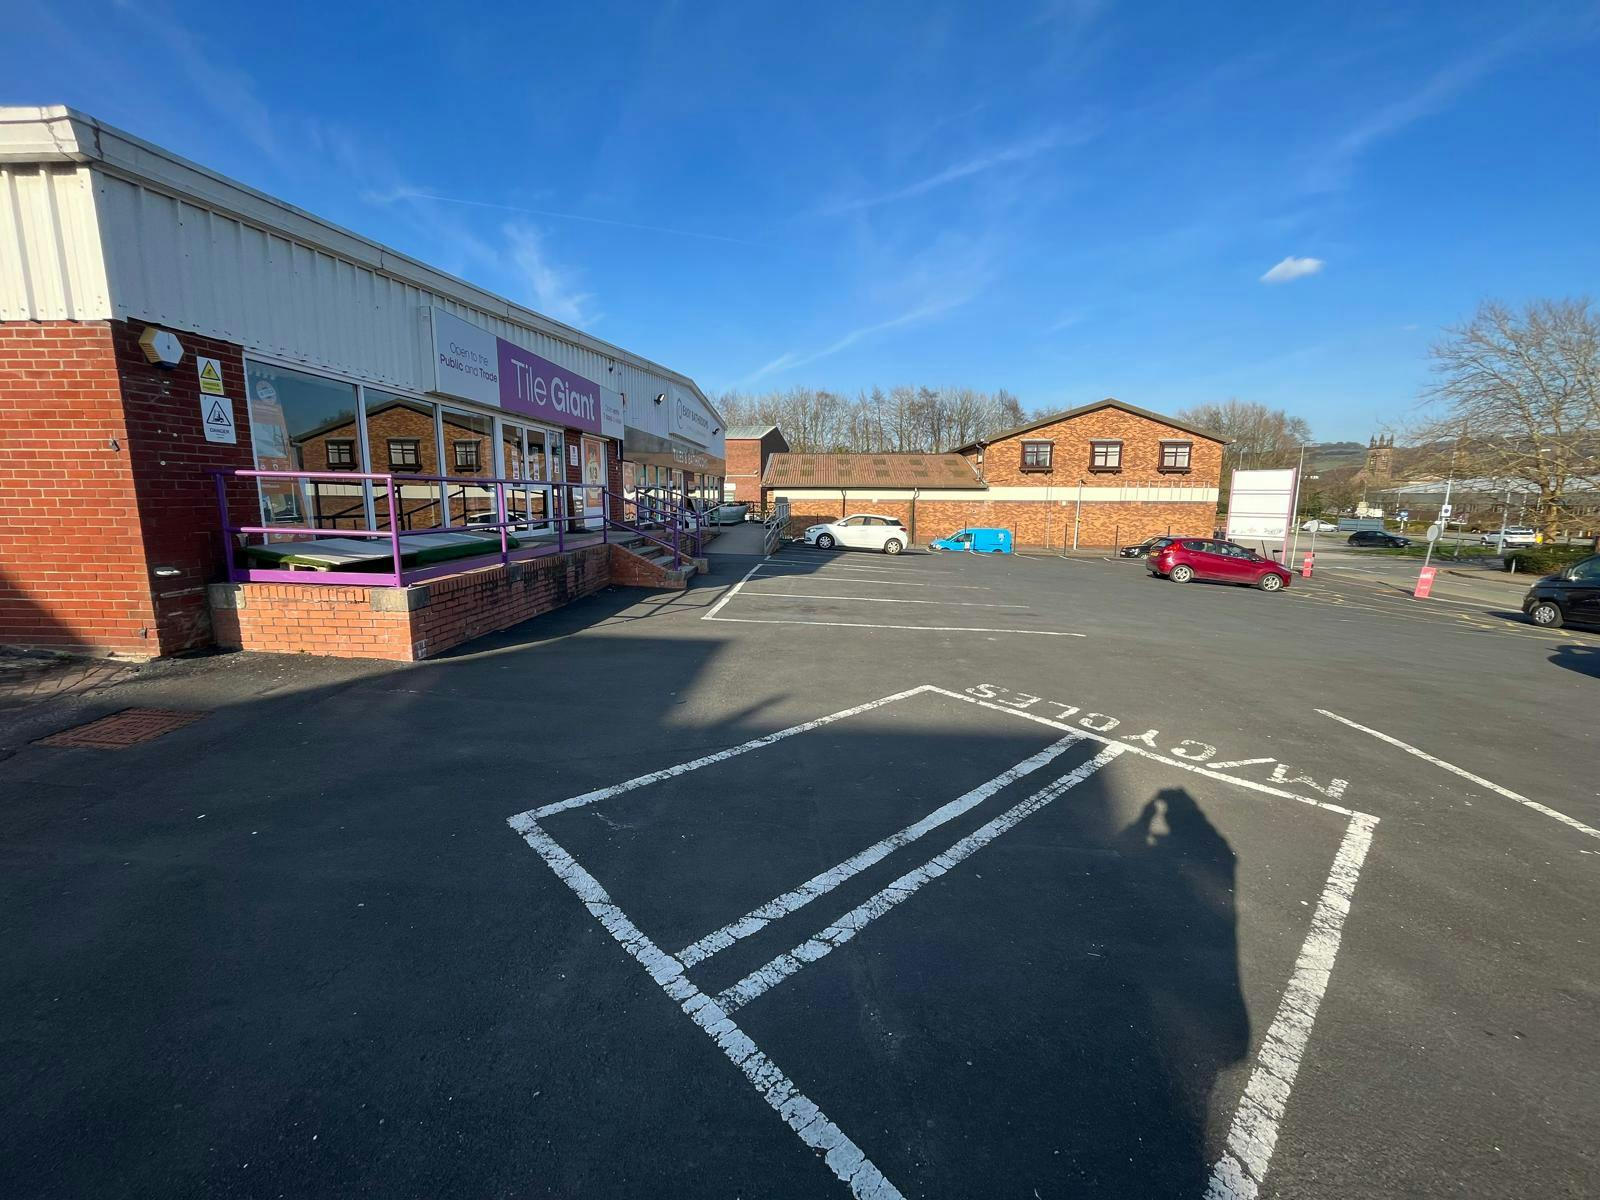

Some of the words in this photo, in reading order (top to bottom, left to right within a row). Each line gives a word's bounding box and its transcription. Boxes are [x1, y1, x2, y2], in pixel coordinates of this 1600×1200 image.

[439, 353, 464, 372] Public
[464, 363, 479, 377] and
[478, 367, 498, 383] Trade
[449, 342, 471, 359] Open
[478, 354, 489, 367] the
[511, 358, 547, 406] Tile
[550, 376, 595, 421] Giant
